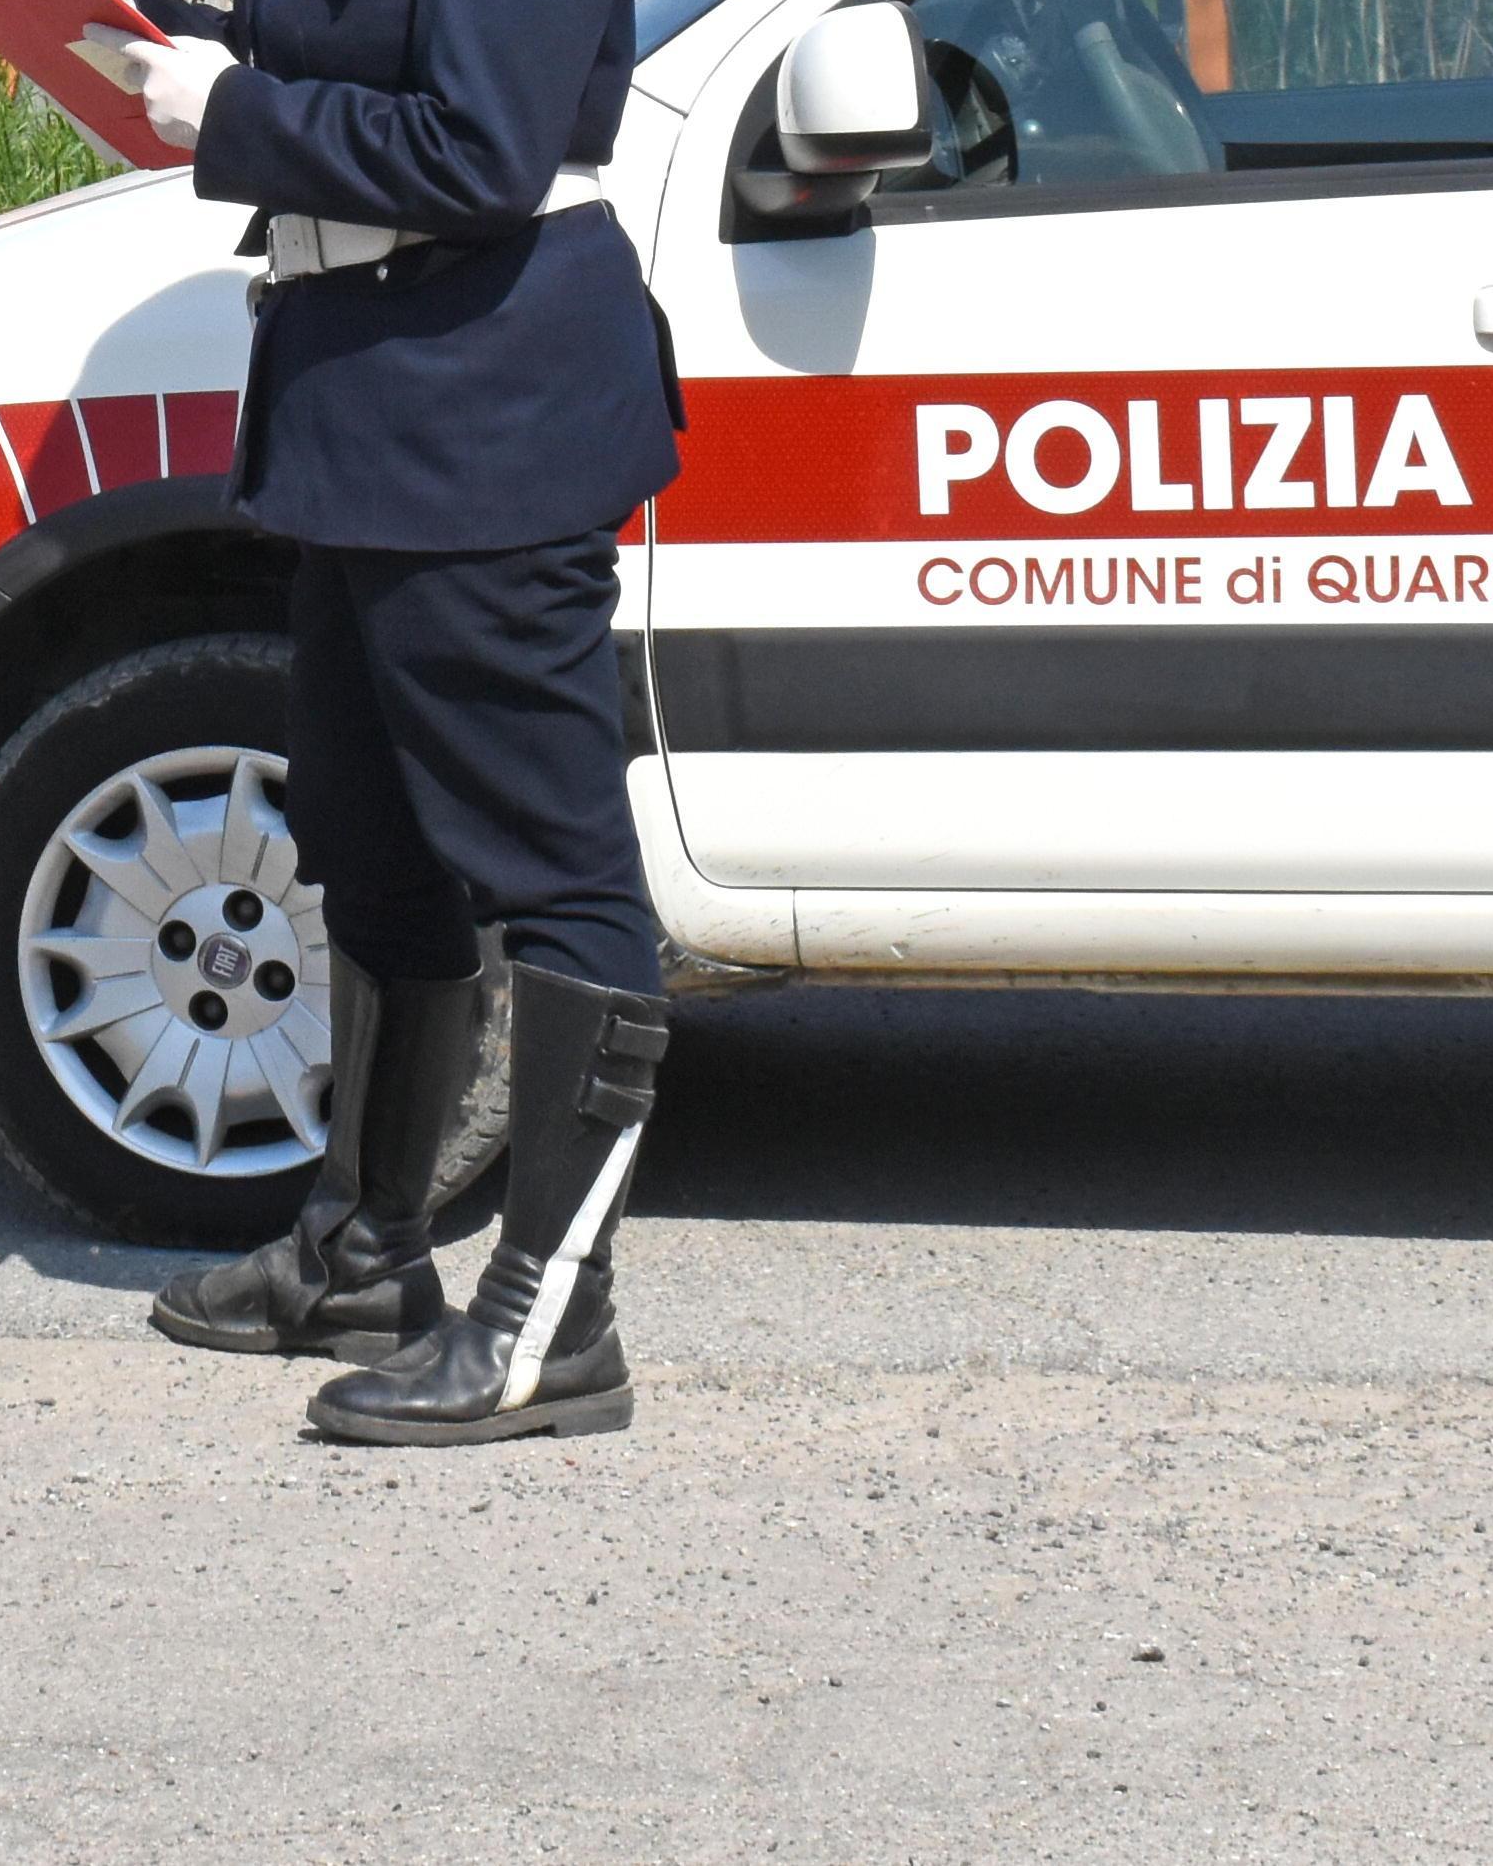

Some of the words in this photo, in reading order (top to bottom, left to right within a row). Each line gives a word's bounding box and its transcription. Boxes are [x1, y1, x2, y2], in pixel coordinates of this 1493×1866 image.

[916, 393, 1472, 515] POLIZIA
[916, 555, 1202, 606] COMUNE
[1226, 552, 1285, 606] di
[212, 944, 239, 978] FIAT
